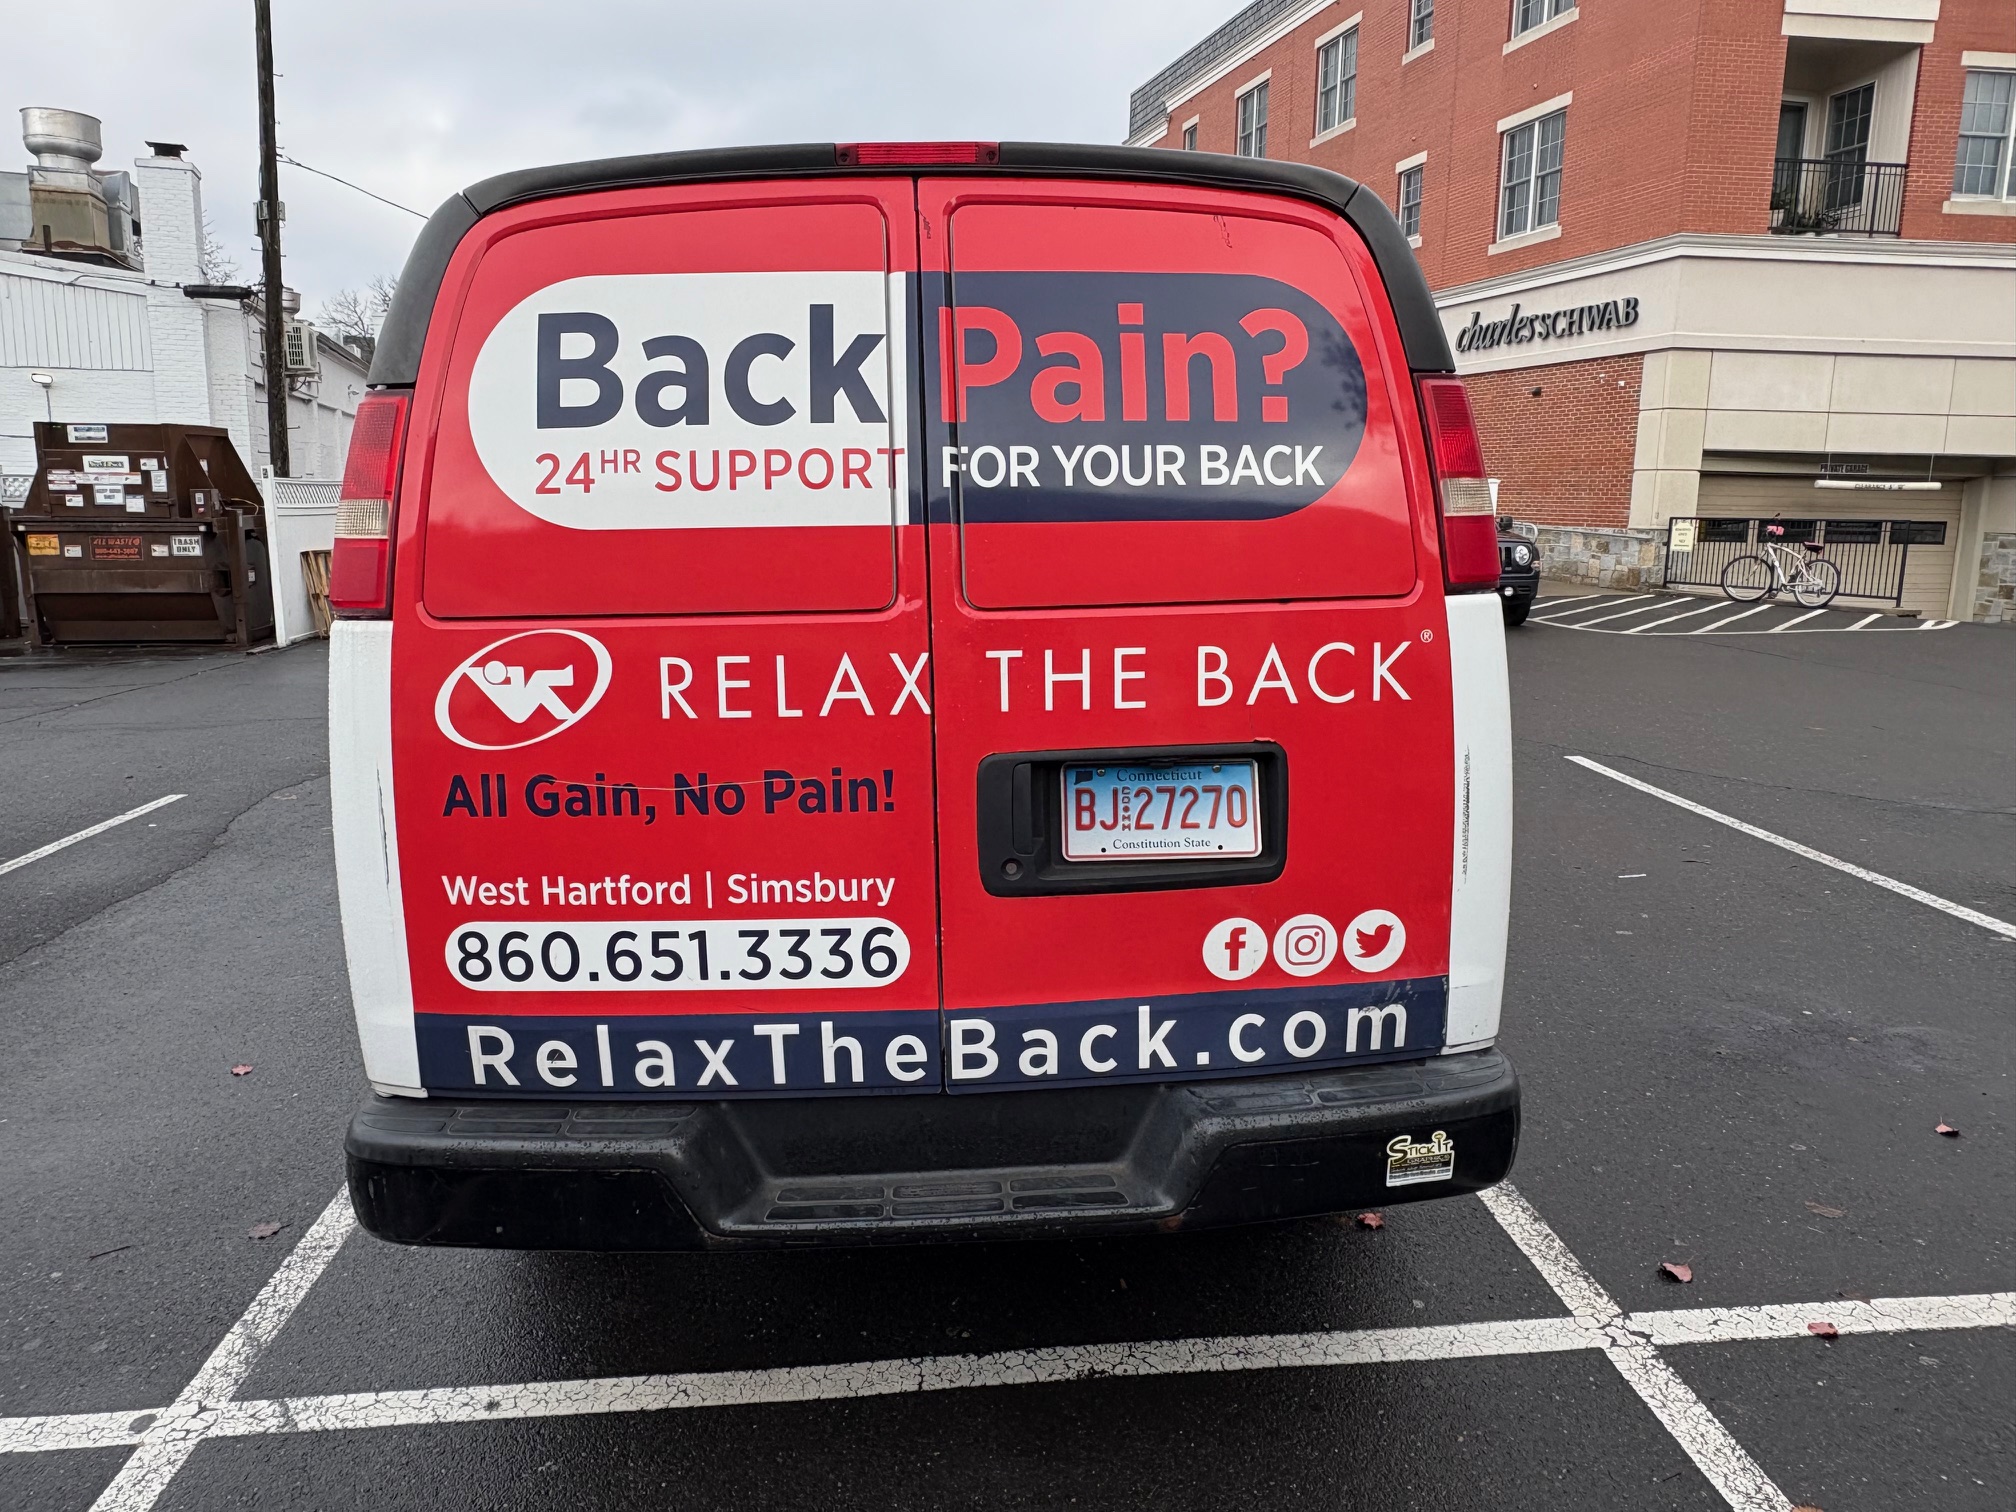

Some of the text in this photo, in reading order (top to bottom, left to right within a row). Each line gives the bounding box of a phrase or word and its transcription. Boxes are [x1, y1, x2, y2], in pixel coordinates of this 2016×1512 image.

[537, 302, 1310, 430] Back Pain?
[654, 447, 906, 492] SUPPORT
[941, 445, 1041, 488] FOR
[1051, 444, 1187, 488] YOUR
[1199, 443, 1326, 486] BACK
[174, 538, 200, 546] TRASH
[659, 651, 932, 720] RELAX
[985, 647, 1147, 713] THE
[442, 766, 896, 827] All Gain, No Pain!
[1116, 768, 1203, 783] Connecticut
[1112, 837, 1212, 850] Constitution State
[441, 875, 530, 907] West
[541, 873, 691, 907] Hartford
[727, 871, 896, 908] Simsbury
[457, 926, 899, 983] 860.651.3336
[467, 1005, 1408, 1088] RelaxTheBack.com
